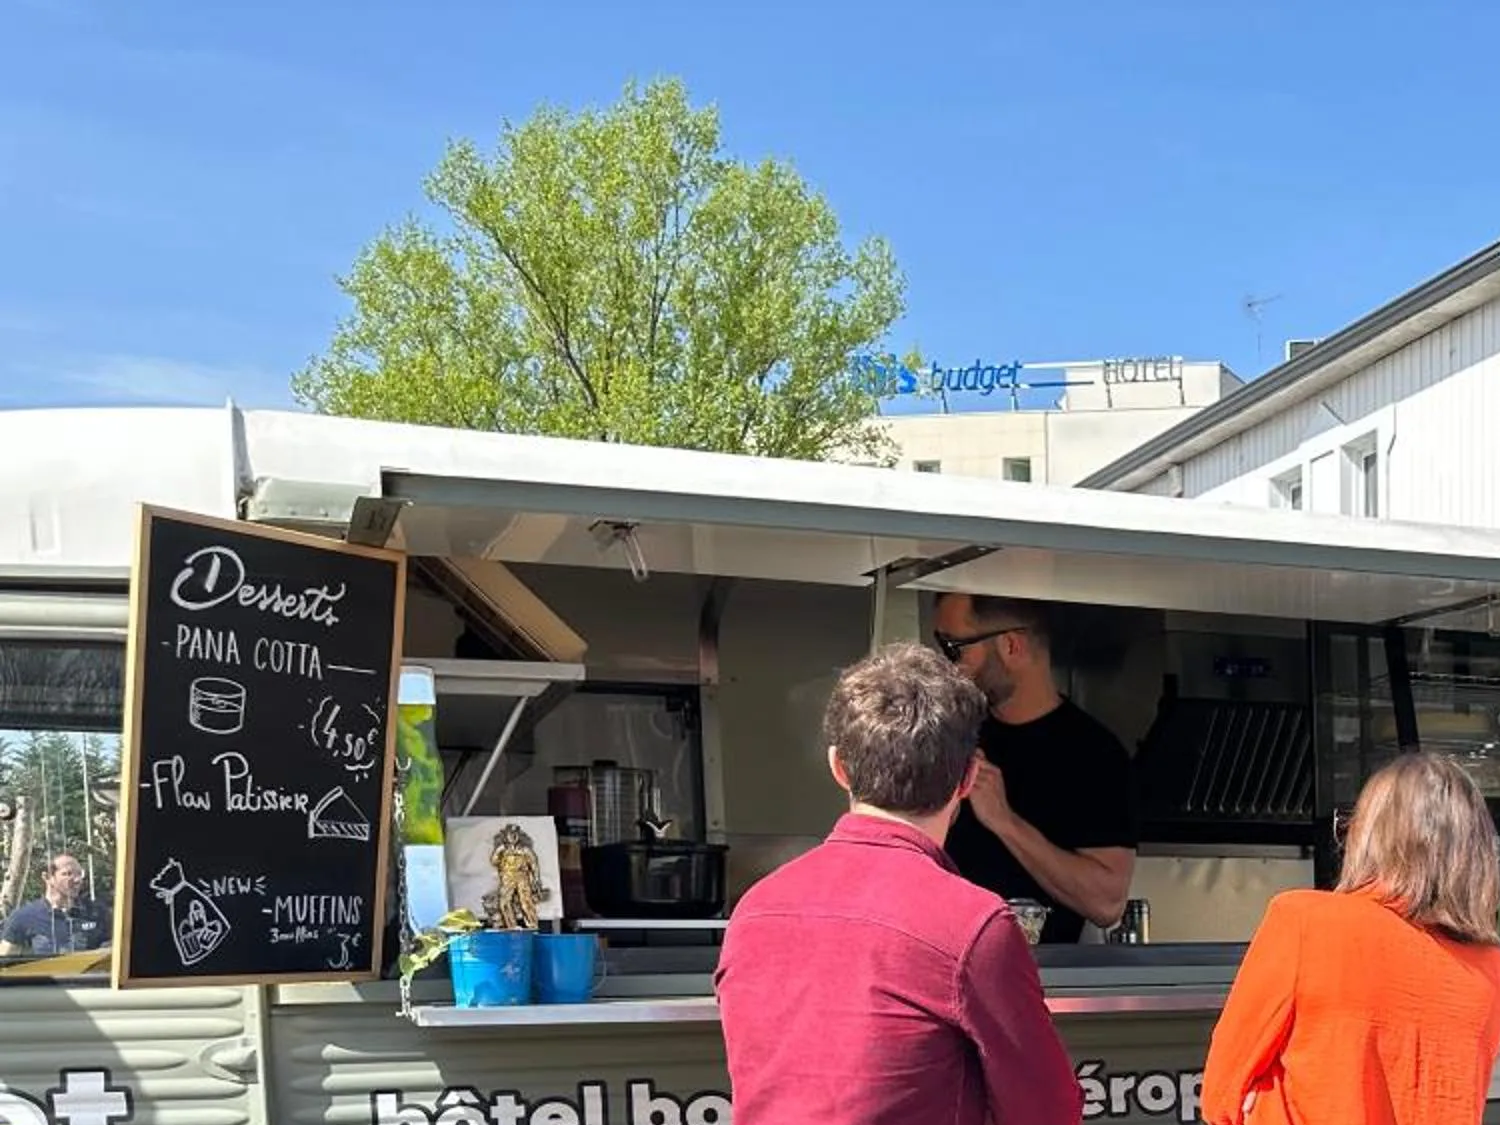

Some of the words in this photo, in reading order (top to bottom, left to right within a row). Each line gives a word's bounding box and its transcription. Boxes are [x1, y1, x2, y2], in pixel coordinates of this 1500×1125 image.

[931, 359, 1023, 396] budget
[1103, 356, 1183, 384] HOTEL
[170, 545, 347, 626] Desserts
[176, 624, 241, 666] PANA
[254, 638, 324, 680] COTTA
[213, 876, 251, 897] NEW
[1079, 1061, 1203, 1125] érop
